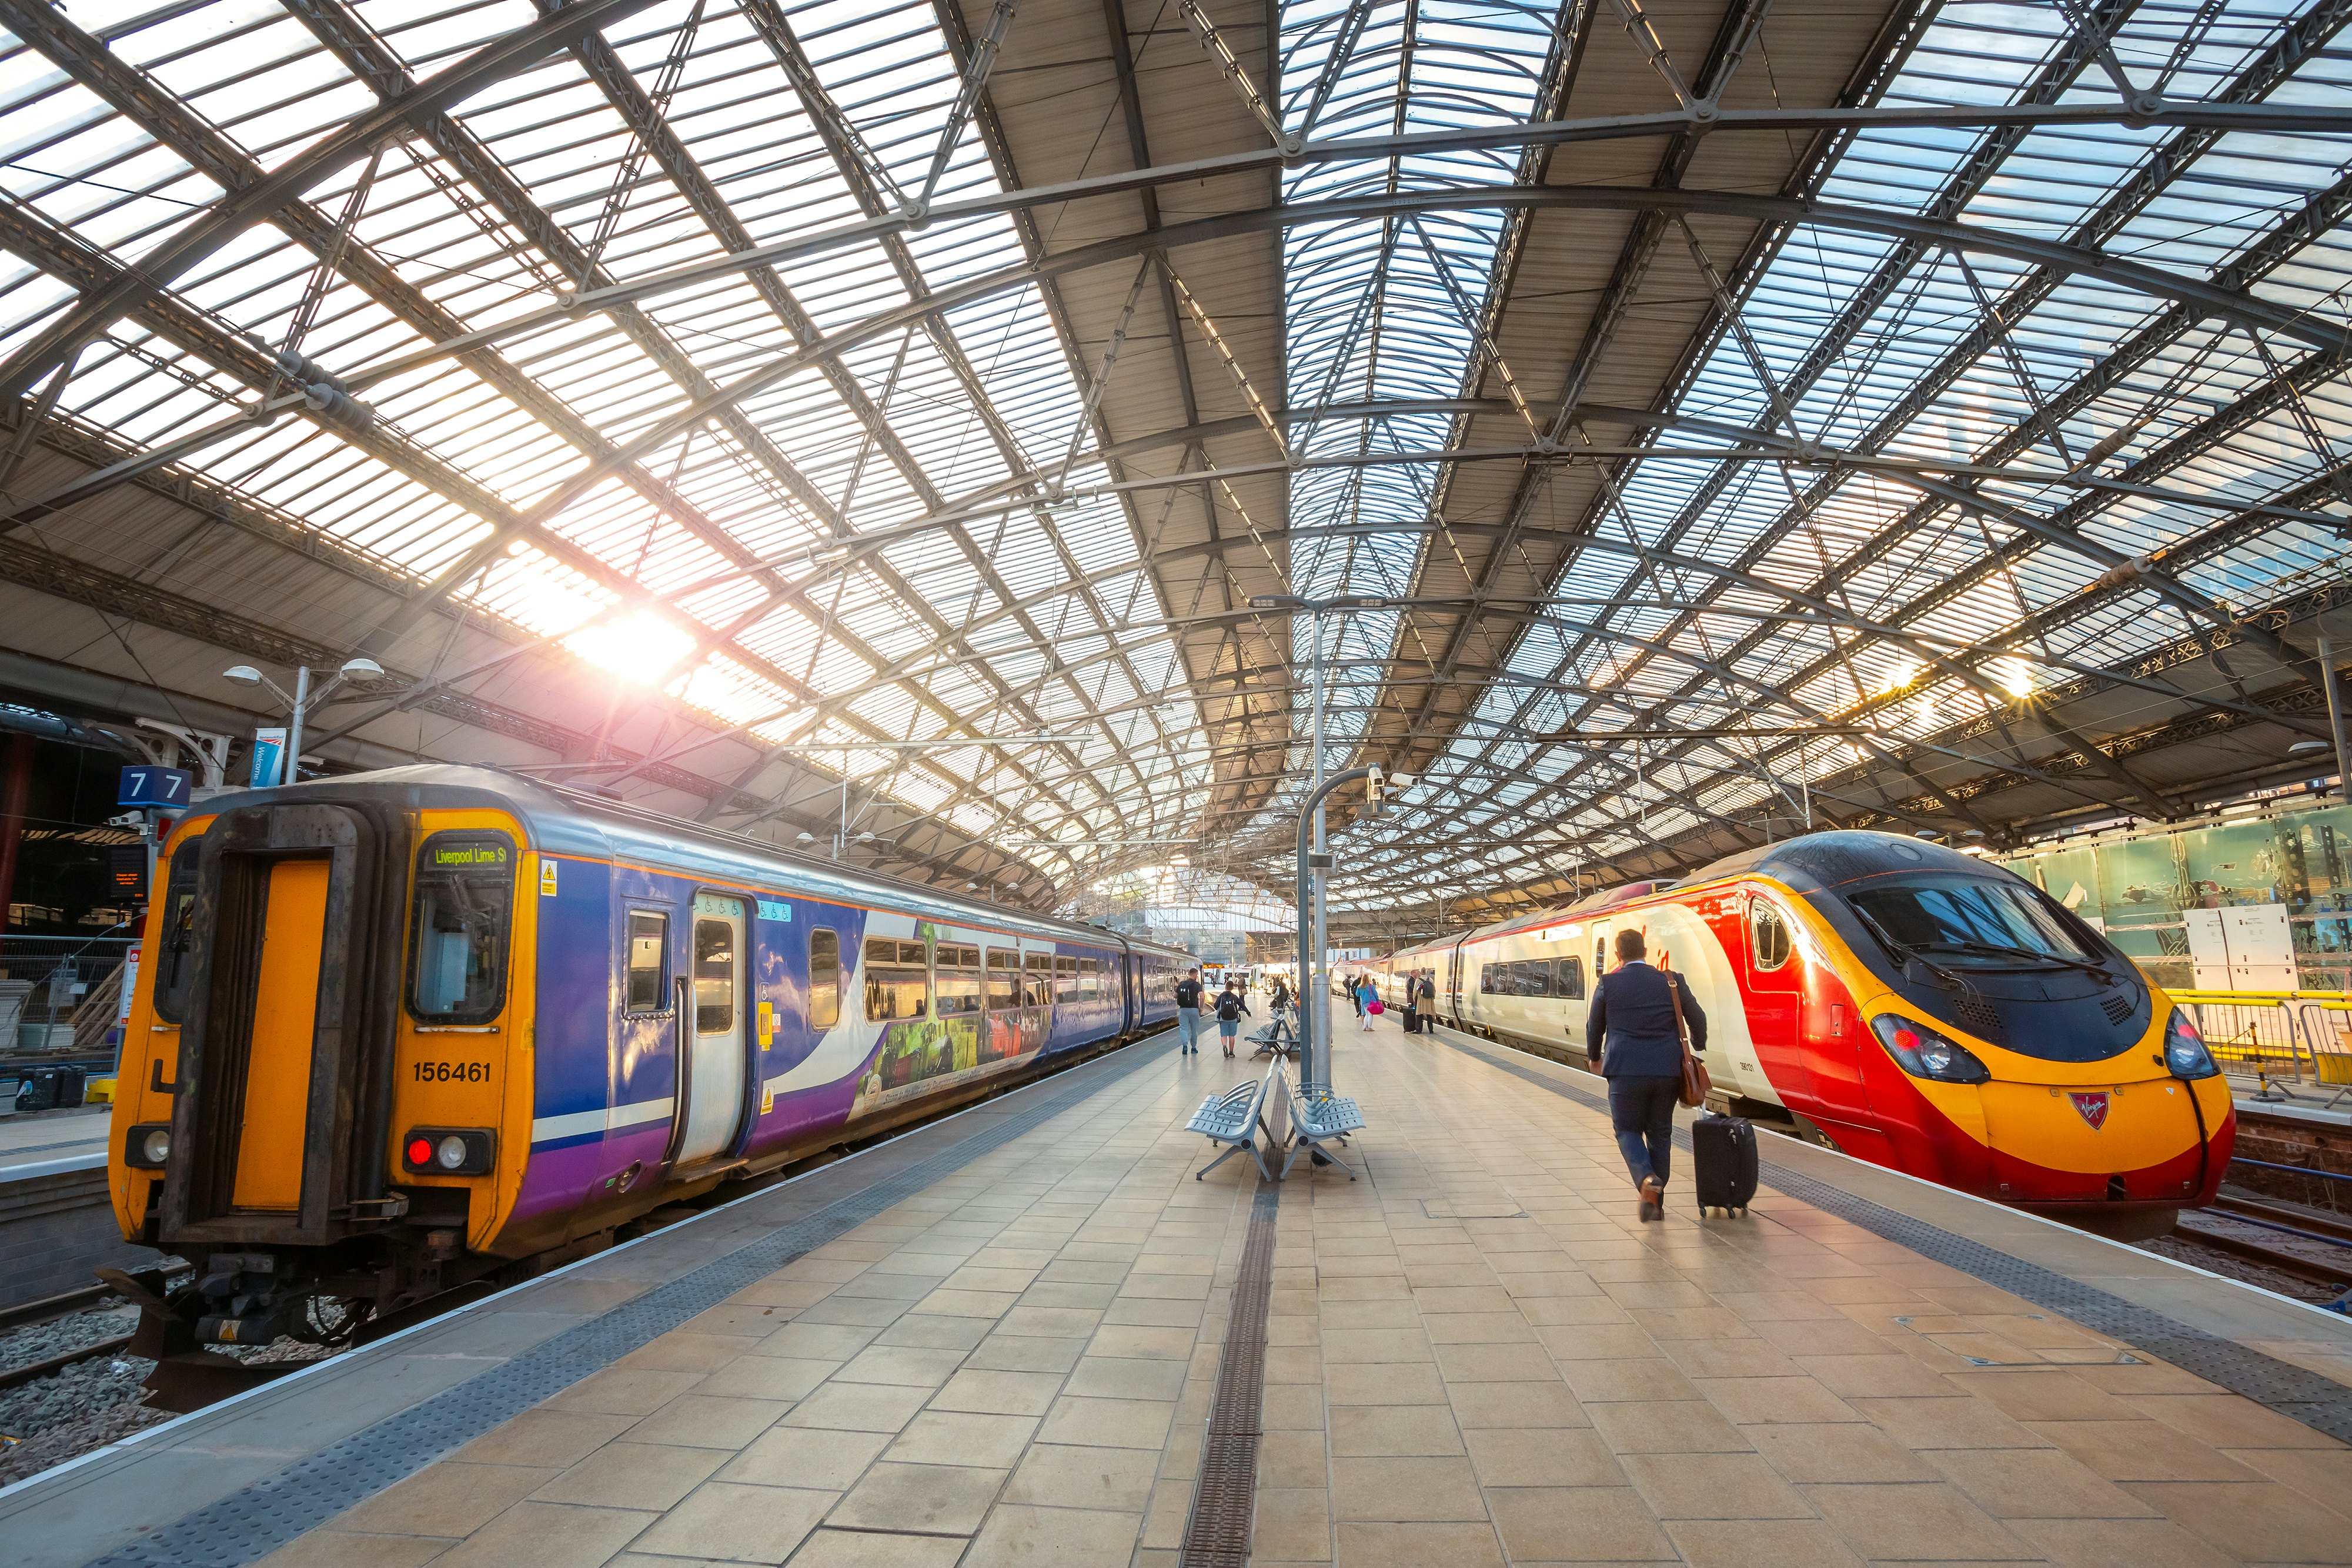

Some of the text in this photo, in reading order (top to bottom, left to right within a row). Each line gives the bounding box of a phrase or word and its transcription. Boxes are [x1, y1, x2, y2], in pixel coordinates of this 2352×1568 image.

[253, 747, 265, 780] Welcome
[131, 773, 146, 796] 7
[166, 775, 182, 798] 7
[436, 848, 473, 866] Liverpool
[475, 848, 496, 862] Lime
[413, 1062, 490, 1082] 156461
[1740, 1062, 1755, 1072] 390131
[2082, 1096, 2105, 1119] Virgin
